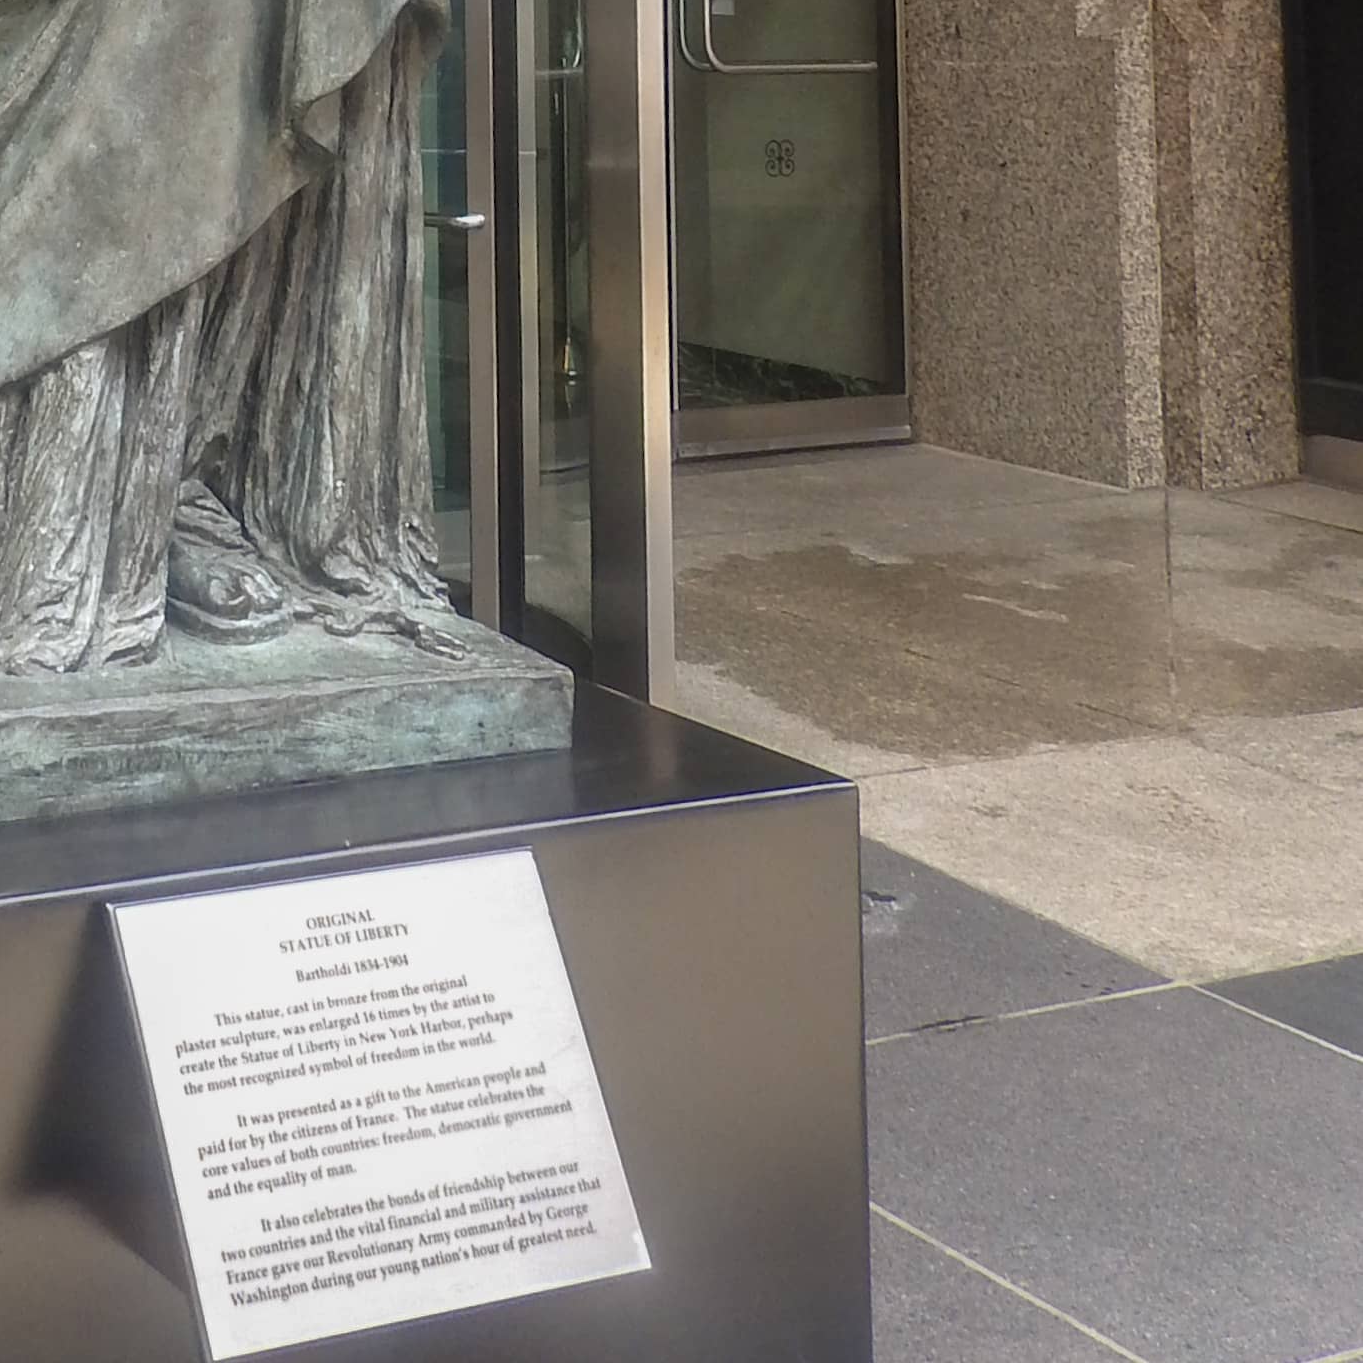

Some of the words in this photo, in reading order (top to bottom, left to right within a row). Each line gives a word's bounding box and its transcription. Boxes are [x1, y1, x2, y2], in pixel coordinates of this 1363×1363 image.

[279, 934, 331, 953] STATUE
[334, 931, 351, 945] OF
[354, 923, 409, 943] LIBERTY
[305, 908, 375, 930] ORIGINAL
[213, 1012, 243, 1027] This
[244, 1008, 285, 1022] statue,
[286, 1001, 310, 1016] cast
[311, 1000, 325, 1012] in
[326, 994, 368, 1009] bronze
[369, 989, 400, 1002] from
[400, 983, 420, 997] the
[422, 974, 468, 994] original
[295, 962, 352, 983] Bartholdi
[354, 953, 409, 974] 1834-1904
[174, 1039, 217, 1060] plaster
[219, 1029, 280, 1048] sculpture,
[282, 1024, 307, 1036] was
[308, 1011, 361, 1033] enlarged
[362, 1010, 377, 1024] 16
[377, 1007, 411, 1021] times
[412, 1002, 428, 1017] by
[429, 999, 449, 1013] the
[452, 994, 482, 1009] artist
[482, 992, 496, 1004] to
[179, 1058, 216, 1076] create
[217, 1054, 238, 1069] the
[240, 1050, 279, 1065] Statue
[281, 1043, 295, 1058] of
[297, 1039, 340, 1056] Liberty
[343, 1036, 358, 1047] in
[358, 1031, 387, 1044] New
[388, 1023, 419, 1040] York
[420, 1018, 466, 1035] Harbor,
[467, 1010, 514, 1031] perhaps
[183, 1081, 204, 1096] the
[206, 1075, 238, 1092] most
[239, 1062, 307, 1087] recognized
[308, 1054, 354, 1077] symbol
[355, 1051, 368, 1067] of
[370, 1046, 421, 1065] freedom
[422, 1042, 436, 1056] in
[436, 1038, 456, 1053] the
[458, 1031, 495, 1049] world.
[236, 1114, 248, 1128] It
[250, 1113, 275, 1126] was
[277, 1098, 338, 1126] presented
[339, 1099, 353, 1110] as
[355, 1097, 363, 1108] a
[364, 1090, 386, 1110] gift
[387, 1090, 401, 1101] to
[401, 1085, 422, 1099] the
[425, 1076, 482, 1094] American
[482, 1066, 522, 1089] people
[524, 1060, 547, 1078] and
[197, 1138, 227, 1162] paid
[228, 1137, 247, 1152] for
[248, 1133, 266, 1151] by
[268, 1129, 289, 1145] the
[290, 1122, 339, 1140] citizens
[340, 1116, 353, 1132] of
[355, 1112, 399, 1129] France.
[403, 1105, 428, 1120] The
[429, 1100, 465, 1115] statue
[466, 1090, 525, 1109] celebrates
[525, 1083, 545, 1098] the
[201, 1164, 229, 1179] core
[230, 1156, 272, 1173] values
[273, 1149, 287, 1166] of
[289, 1144, 320, 1163] both
[320, 1137, 380, 1157] countries:
[381, 1127, 436, 1146] freedom,
[438, 1113, 501, 1135] democratic
[503, 1099, 573, 1125] government
[207, 1182, 232, 1201] and
[233, 1180, 254, 1196] the
[256, 1170, 308, 1194] equality
[309, 1165, 324, 1181] of
[325, 1163, 356, 1178] man.
[260, 1218, 273, 1233] It
[274, 1214, 301, 1231] also
[301, 1203, 364, 1225] celebrates
[364, 1197, 386, 1213] the
[387, 1188, 426, 1209] bonds
[427, 1184, 441, 1201] of
[442, 1175, 506, 1198] friendship
[506, 1166, 558, 1185] between
[558, 1161, 579, 1175] our
[220, 1248, 247, 1264] two
[248, 1235, 308, 1258] countries
[309, 1227, 334, 1246] and
[334, 1225, 356, 1241] the
[357, 1216, 387, 1236] vital
[387, 1206, 442, 1231] financial
[444, 1202, 468, 1220] and
[468, 1196, 516, 1215] military
[518, 1184, 576, 1204] assistance
[577, 1176, 602, 1193] that
[225, 1267, 269, 1286] France
[270, 1260, 301, 1281] gave
[302, 1255, 325, 1270] our
[325, 1238, 414, 1266] Revolutionary
[418, 1231, 451, 1248] Army
[453, 1211, 527, 1240] commanded
[527, 1210, 543, 1227] by
[545, 1204, 589, 1220] George
[229, 1282, 310, 1307] Washington
[310, 1272, 356, 1291] during
[355, 1267, 377, 1282] our
[379, 1259, 421, 1282] young
[420, 1246, 470, 1270] nation's
[470, 1243, 500, 1259] hour
[502, 1235, 515, 1252] of
[517, 1228, 564, 1254] greatest
[565, 1220, 597, 1239] need.
